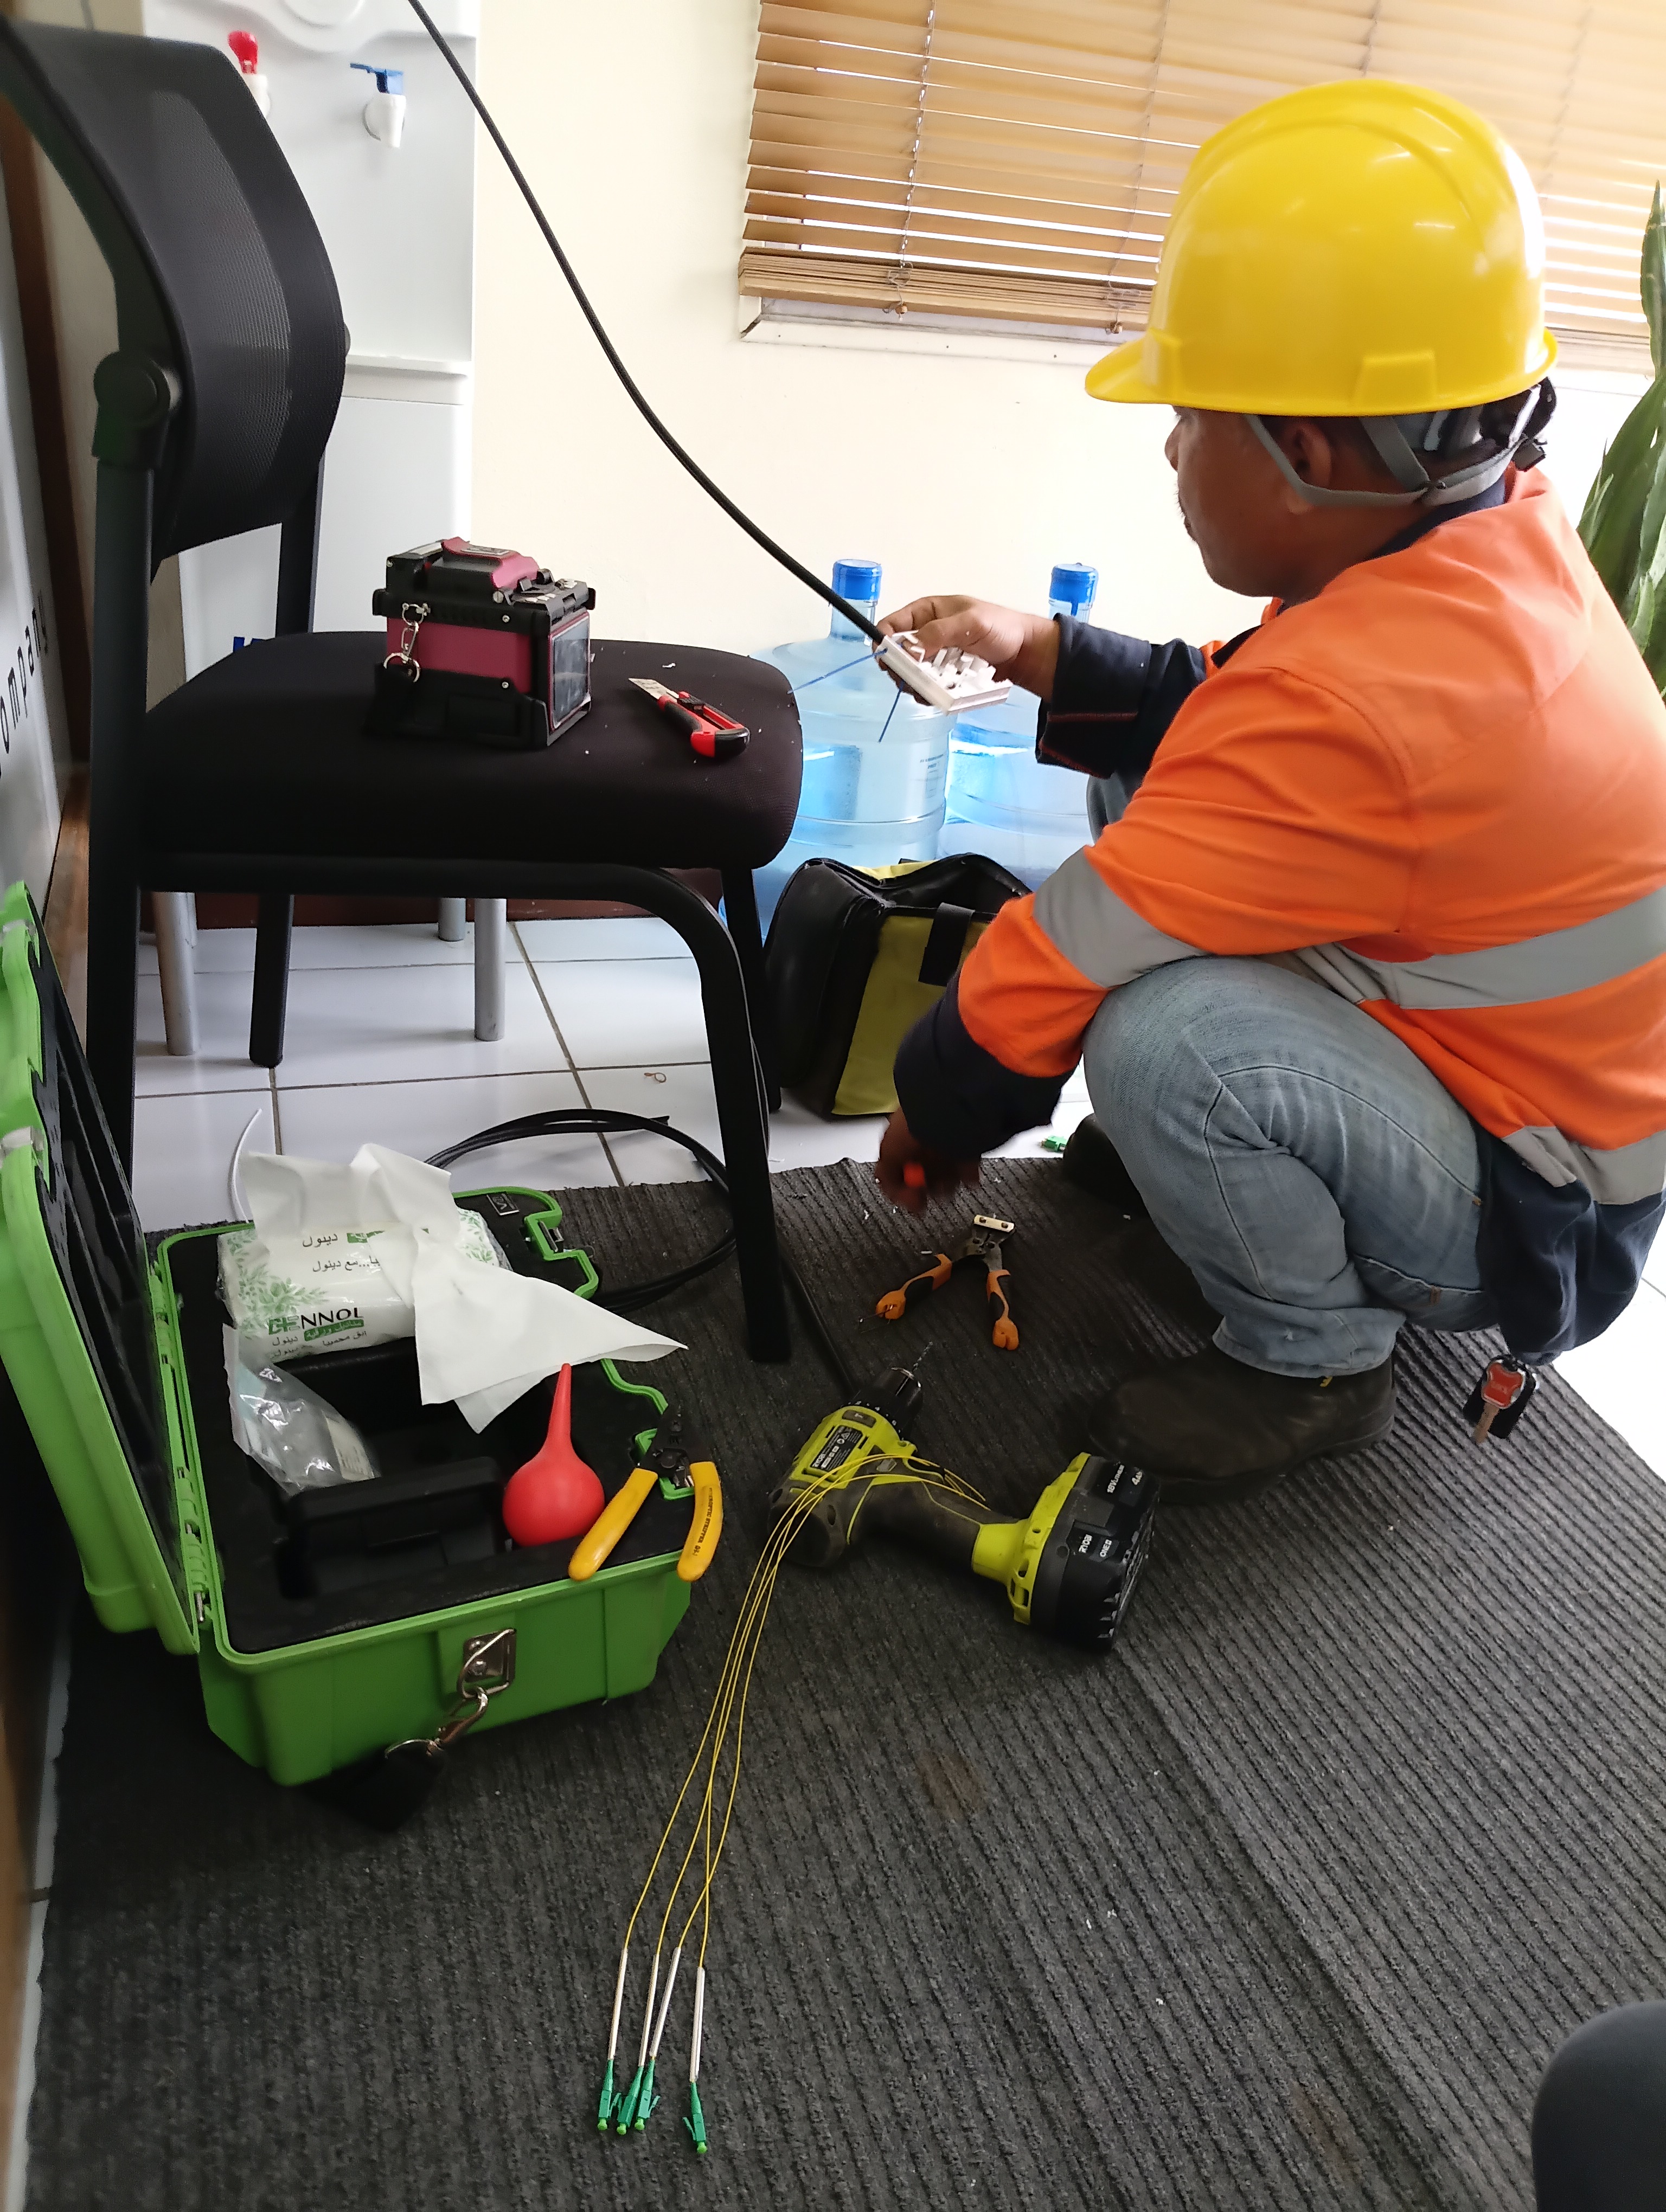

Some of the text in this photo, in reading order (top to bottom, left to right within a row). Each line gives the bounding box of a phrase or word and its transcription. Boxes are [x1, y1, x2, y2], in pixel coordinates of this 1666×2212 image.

[0, 589, 48, 781] ompany
[302, 1233, 338, 1248] دينول
[1079, 1534, 1092, 1553] RYOBI
